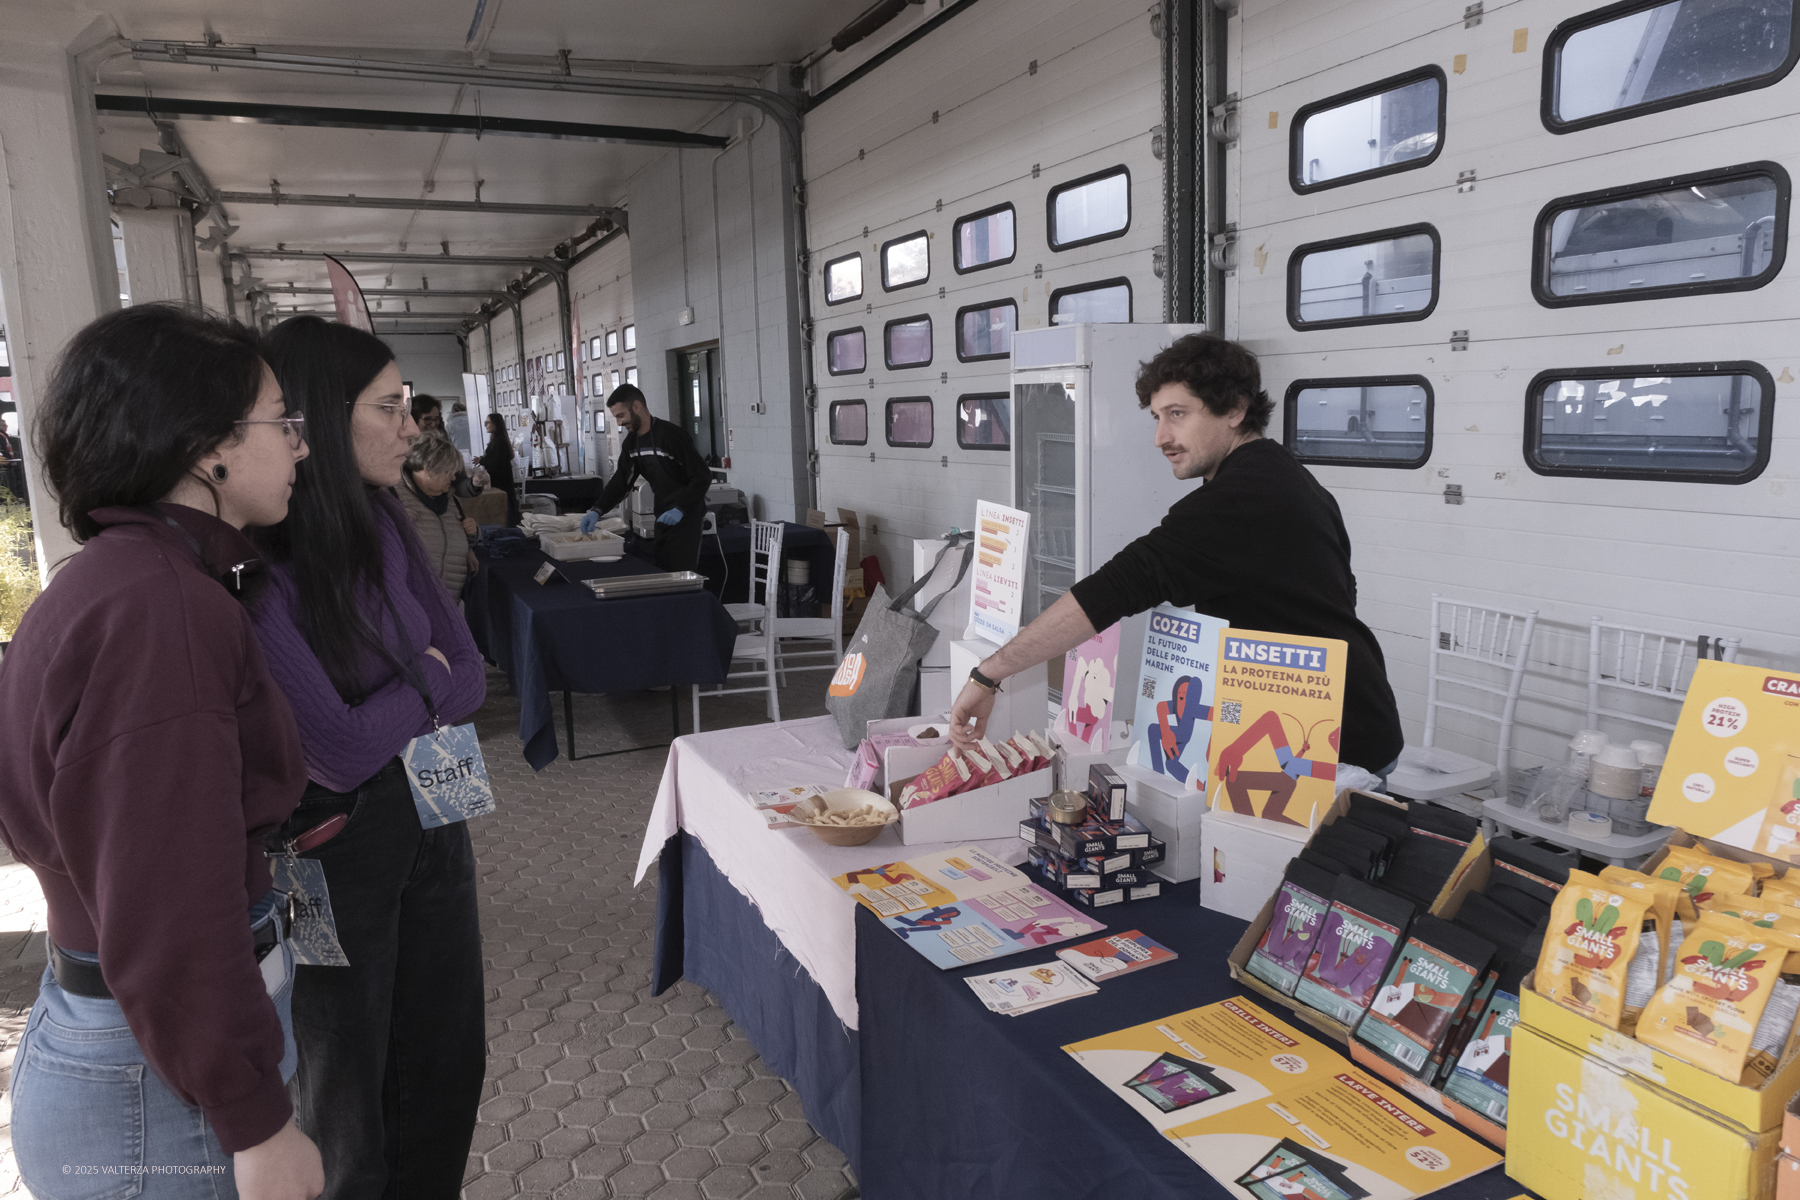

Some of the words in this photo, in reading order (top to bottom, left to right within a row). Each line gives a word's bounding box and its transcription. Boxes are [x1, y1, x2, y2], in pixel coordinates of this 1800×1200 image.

[982, 508, 1000, 520] LINEA
[1002, 514, 1024, 528] INSETTI
[976, 568, 992, 580] LINEA
[994, 575, 1018, 590] LIEVITI
[1152, 616, 1198, 640] COZZE
[1148, 635, 1156, 644] IL
[1158, 638, 1188, 653] FUTURO
[1228, 641, 1322, 668] INSETTI
[1145, 658, 1174, 674] MARINE
[1147, 646, 1168, 660] DELLE
[1170, 654, 1210, 672] PROTEINE
[1224, 664, 1240, 676] LA
[1242, 667, 1302, 684] PROTEINA
[1307, 672, 1330, 687] PIÙ
[1222, 677, 1332, 701] RIVOLUZIONARIA
[1767, 680, 1800, 694] CRA
[1707, 714, 1739, 730] 21%
[1711, 708, 1741, 718] PROTEIN
[418, 757, 474, 788] Staff
[300, 898, 322, 919] aff
[1284, 905, 1317, 926] GIANTS
[1290, 899, 1317, 918] SMALL
[1336, 927, 1374, 950] GIANTS
[1342, 919, 1374, 941] SMALL
[1575, 925, 1614, 947] SMALL
[1567, 935, 1615, 959] GIANTS
[1409, 964, 1448, 990] GIANTS
[1416, 957, 1450, 980] SMALL
[1684, 964, 1748, 991] GIANTS
[1697, 959, 1748, 978] SMALL
[1700, 995, 1725, 1006] CRICKET
[1726, 1004, 1745, 1014] FLOUR
[1223, 1001, 1259, 1024] GRILLI
[1255, 1022, 1295, 1045] INTERI
[1273, 1056, 1298, 1072] 57%
[1337, 1075, 1379, 1100] LARVE
[1374, 1099, 1428, 1131] INTERE
[1556, 1082, 1681, 1173] SMALL
[1409, 1150, 1440, 1169] 52%
[1544, 1108, 1690, 1200] GIANTS
